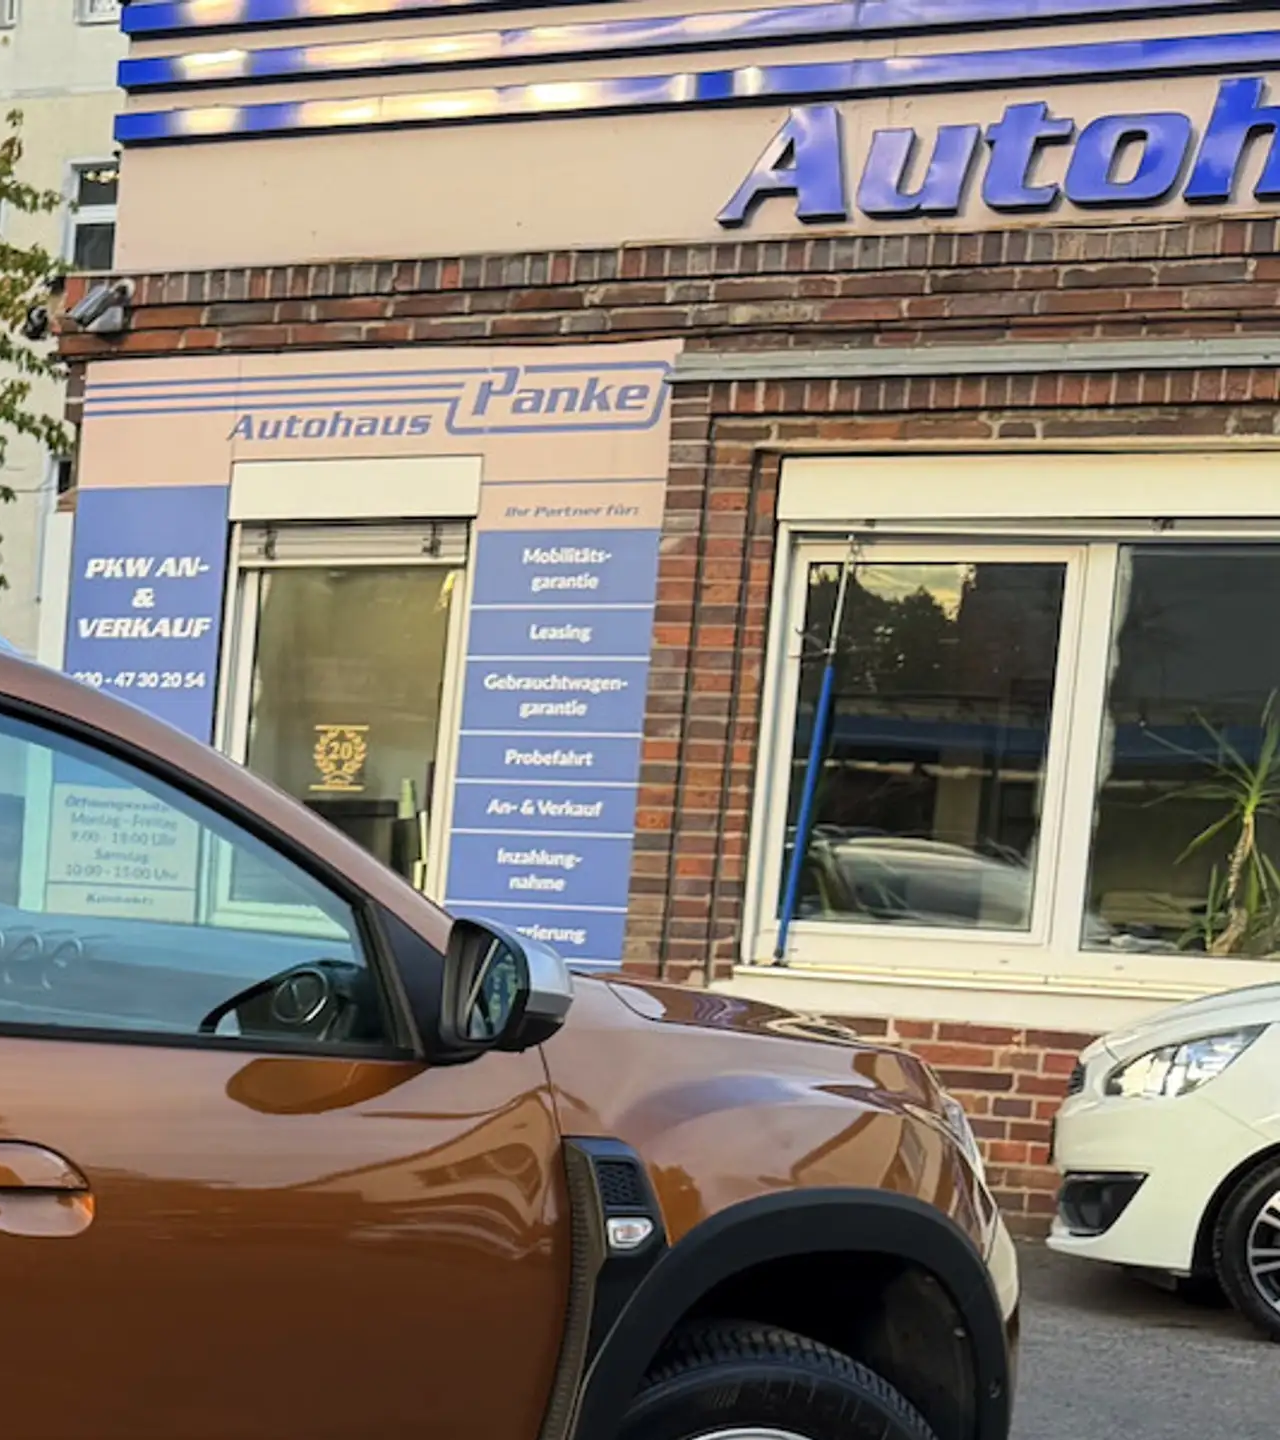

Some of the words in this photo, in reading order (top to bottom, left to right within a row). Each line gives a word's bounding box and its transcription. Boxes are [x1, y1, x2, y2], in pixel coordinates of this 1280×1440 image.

[226, 411, 433, 442] Autohaus
[471, 366, 650, 416] Panke
[505, 506, 530, 517] Ihr
[534, 506, 602, 518] Partner
[606, 503, 639, 516] für:
[522, 547, 612, 565] Mobilitäts-
[85, 557, 155, 578] PKW
[155, 557, 210, 578] AN-
[531, 572, 599, 592] garantie
[132, 587, 155, 608] &
[78, 617, 212, 638] VERKAUF
[529, 624, 593, 643] Leasing
[114, 672, 136, 688] 47
[136, 672, 158, 687] 30
[159, 672, 182, 687] 20
[183, 672, 206, 688] 54
[483, 674, 628, 694] Gebrauchtwagen-
[519, 700, 587, 718] garantie
[328, 741, 352, 760] 20
[504, 749, 594, 766] Probefahrt
[486, 799, 518, 815] An-
[520, 799, 534, 815] &
[537, 799, 603, 817] Verkauf
[497, 848, 583, 869] Inzahlung-
[509, 874, 566, 891] nahme
